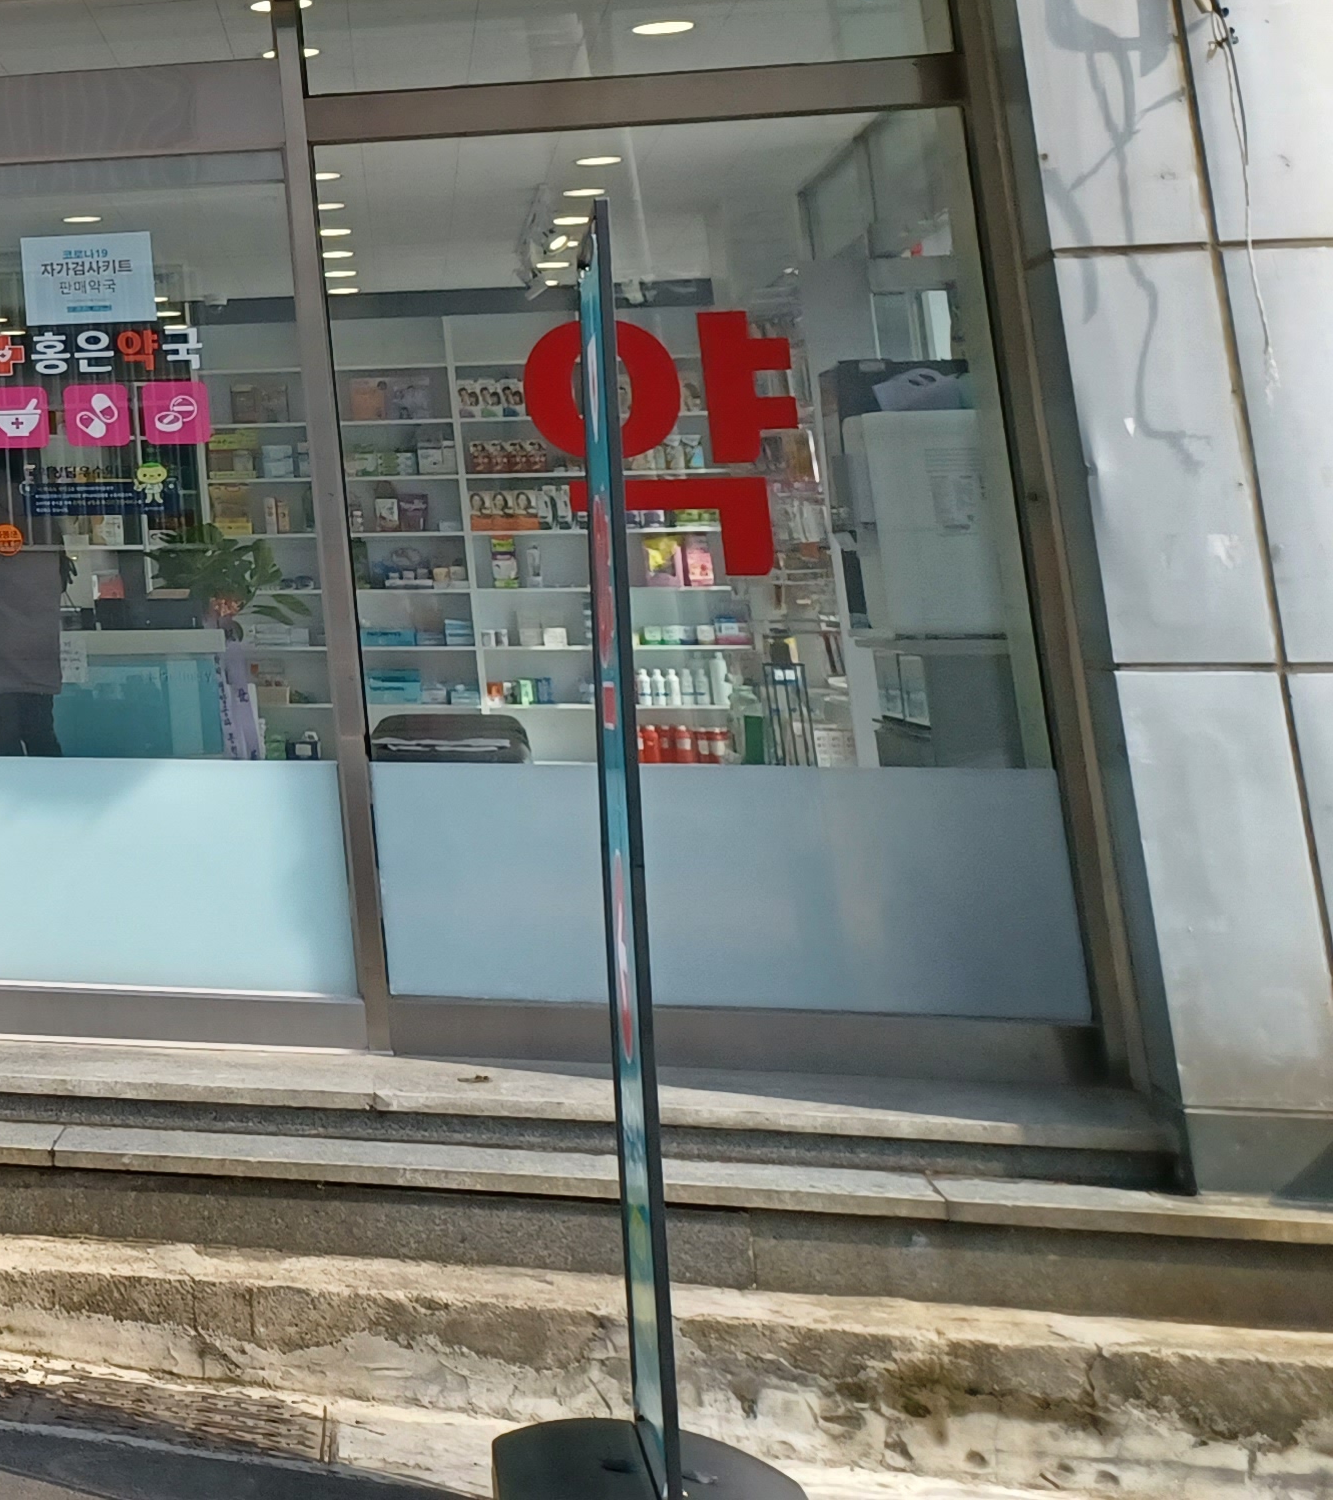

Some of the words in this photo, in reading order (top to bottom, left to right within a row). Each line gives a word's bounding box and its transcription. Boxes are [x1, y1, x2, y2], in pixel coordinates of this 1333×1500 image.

[62, 248, 108, 260] 코로나19
[41, 259, 133, 277] 자가검사키트
[59, 278, 117, 296] 판매약국
[31, 327, 203, 376] 홍은약국
[523, 310, 799, 578] 약
